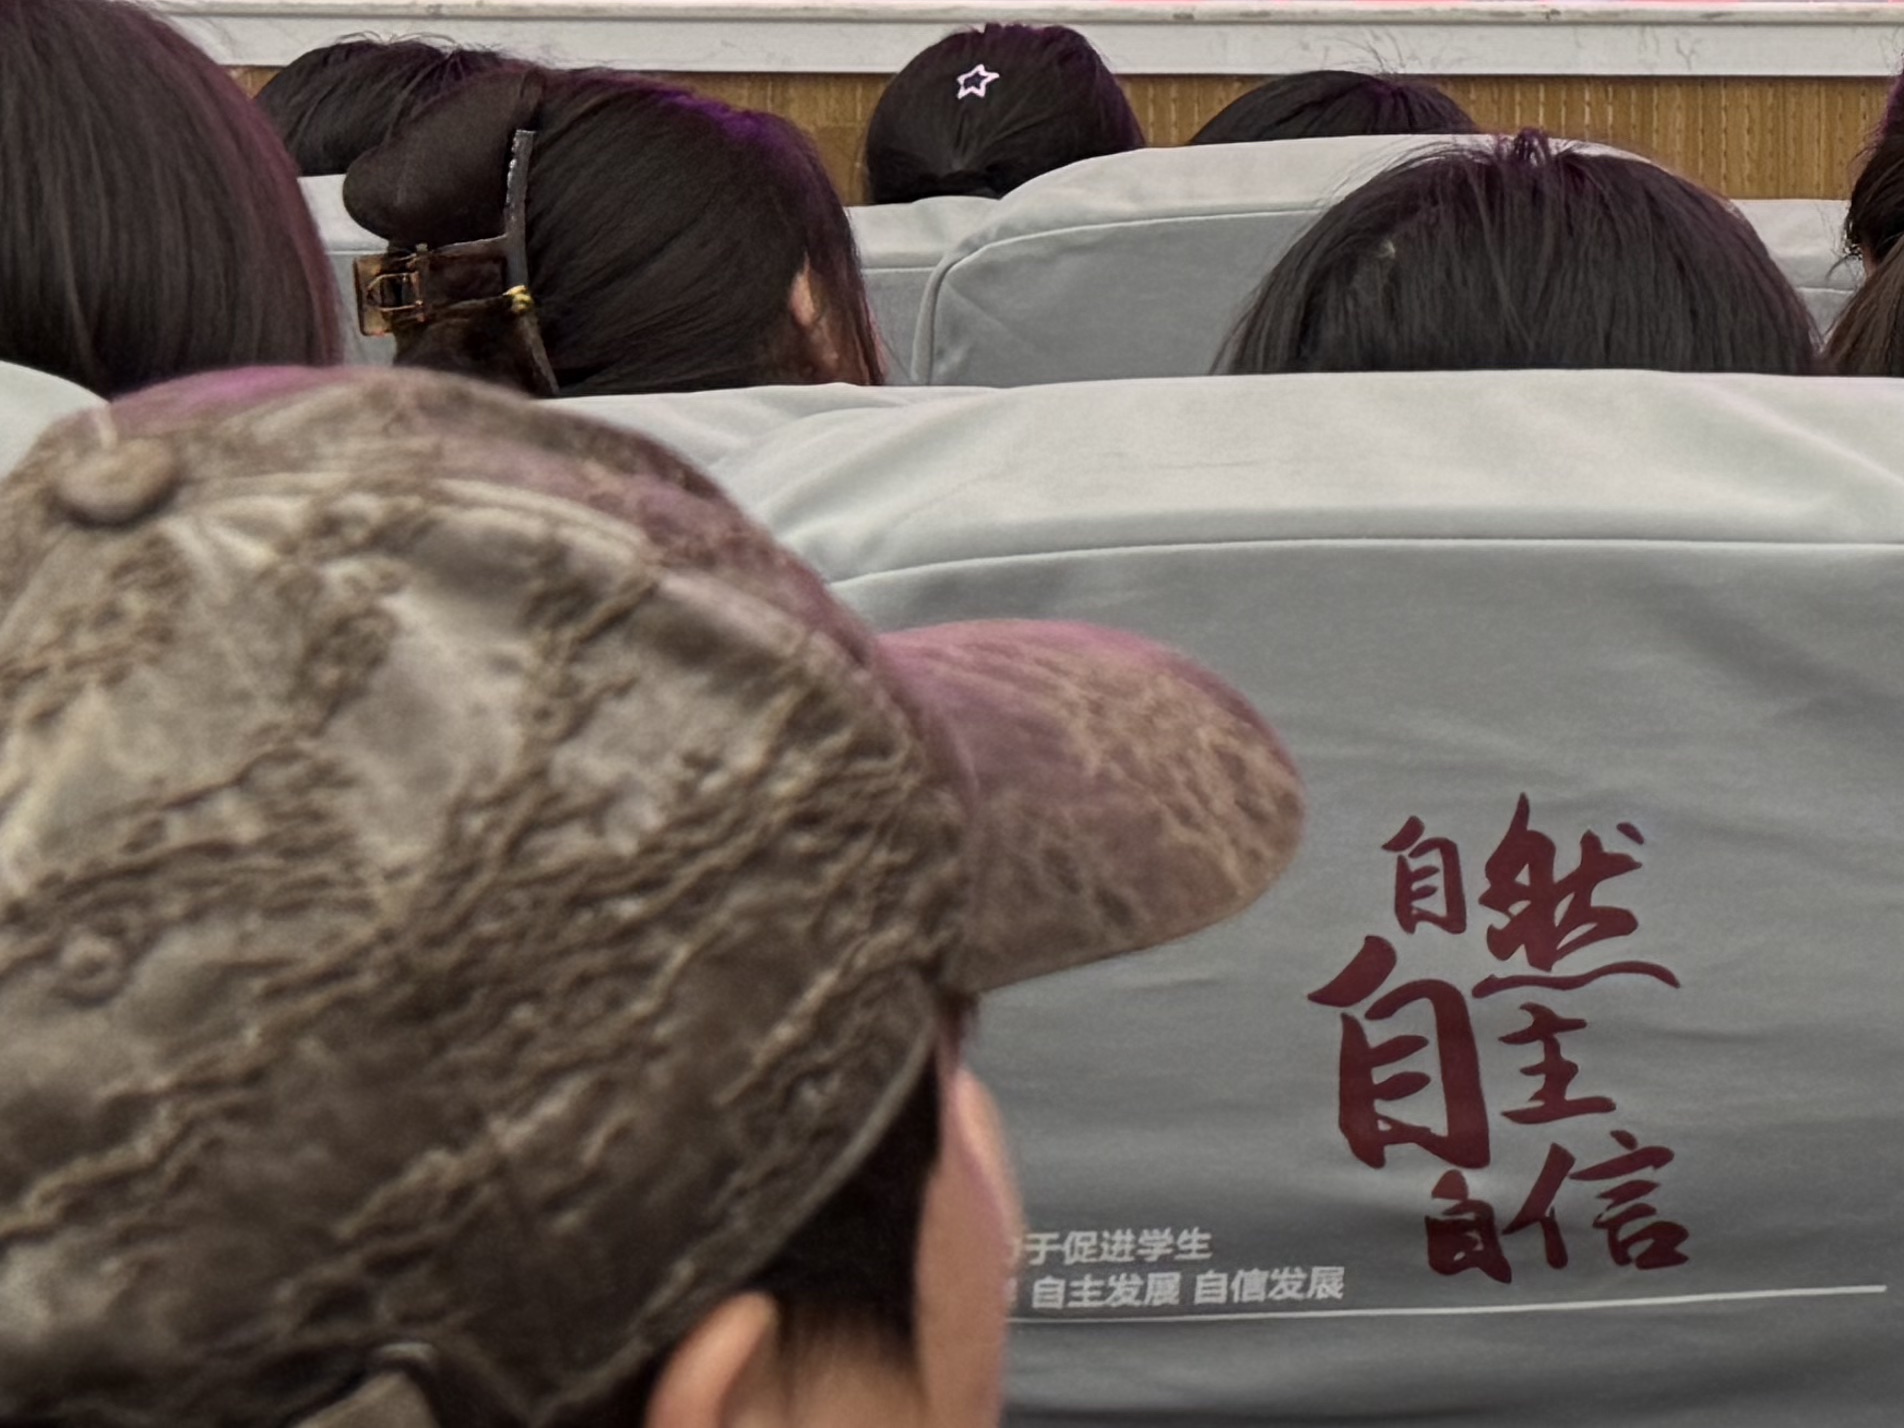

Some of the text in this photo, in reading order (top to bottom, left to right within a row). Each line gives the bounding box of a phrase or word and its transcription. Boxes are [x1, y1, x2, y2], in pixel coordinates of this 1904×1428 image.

[1382, 792, 1681, 998] 自然
[1308, 935, 1617, 1169] 自主
[1032, 1265, 1346, 1310] 自主发展 自信发展
[1425, 1131, 1689, 1283] 自信
